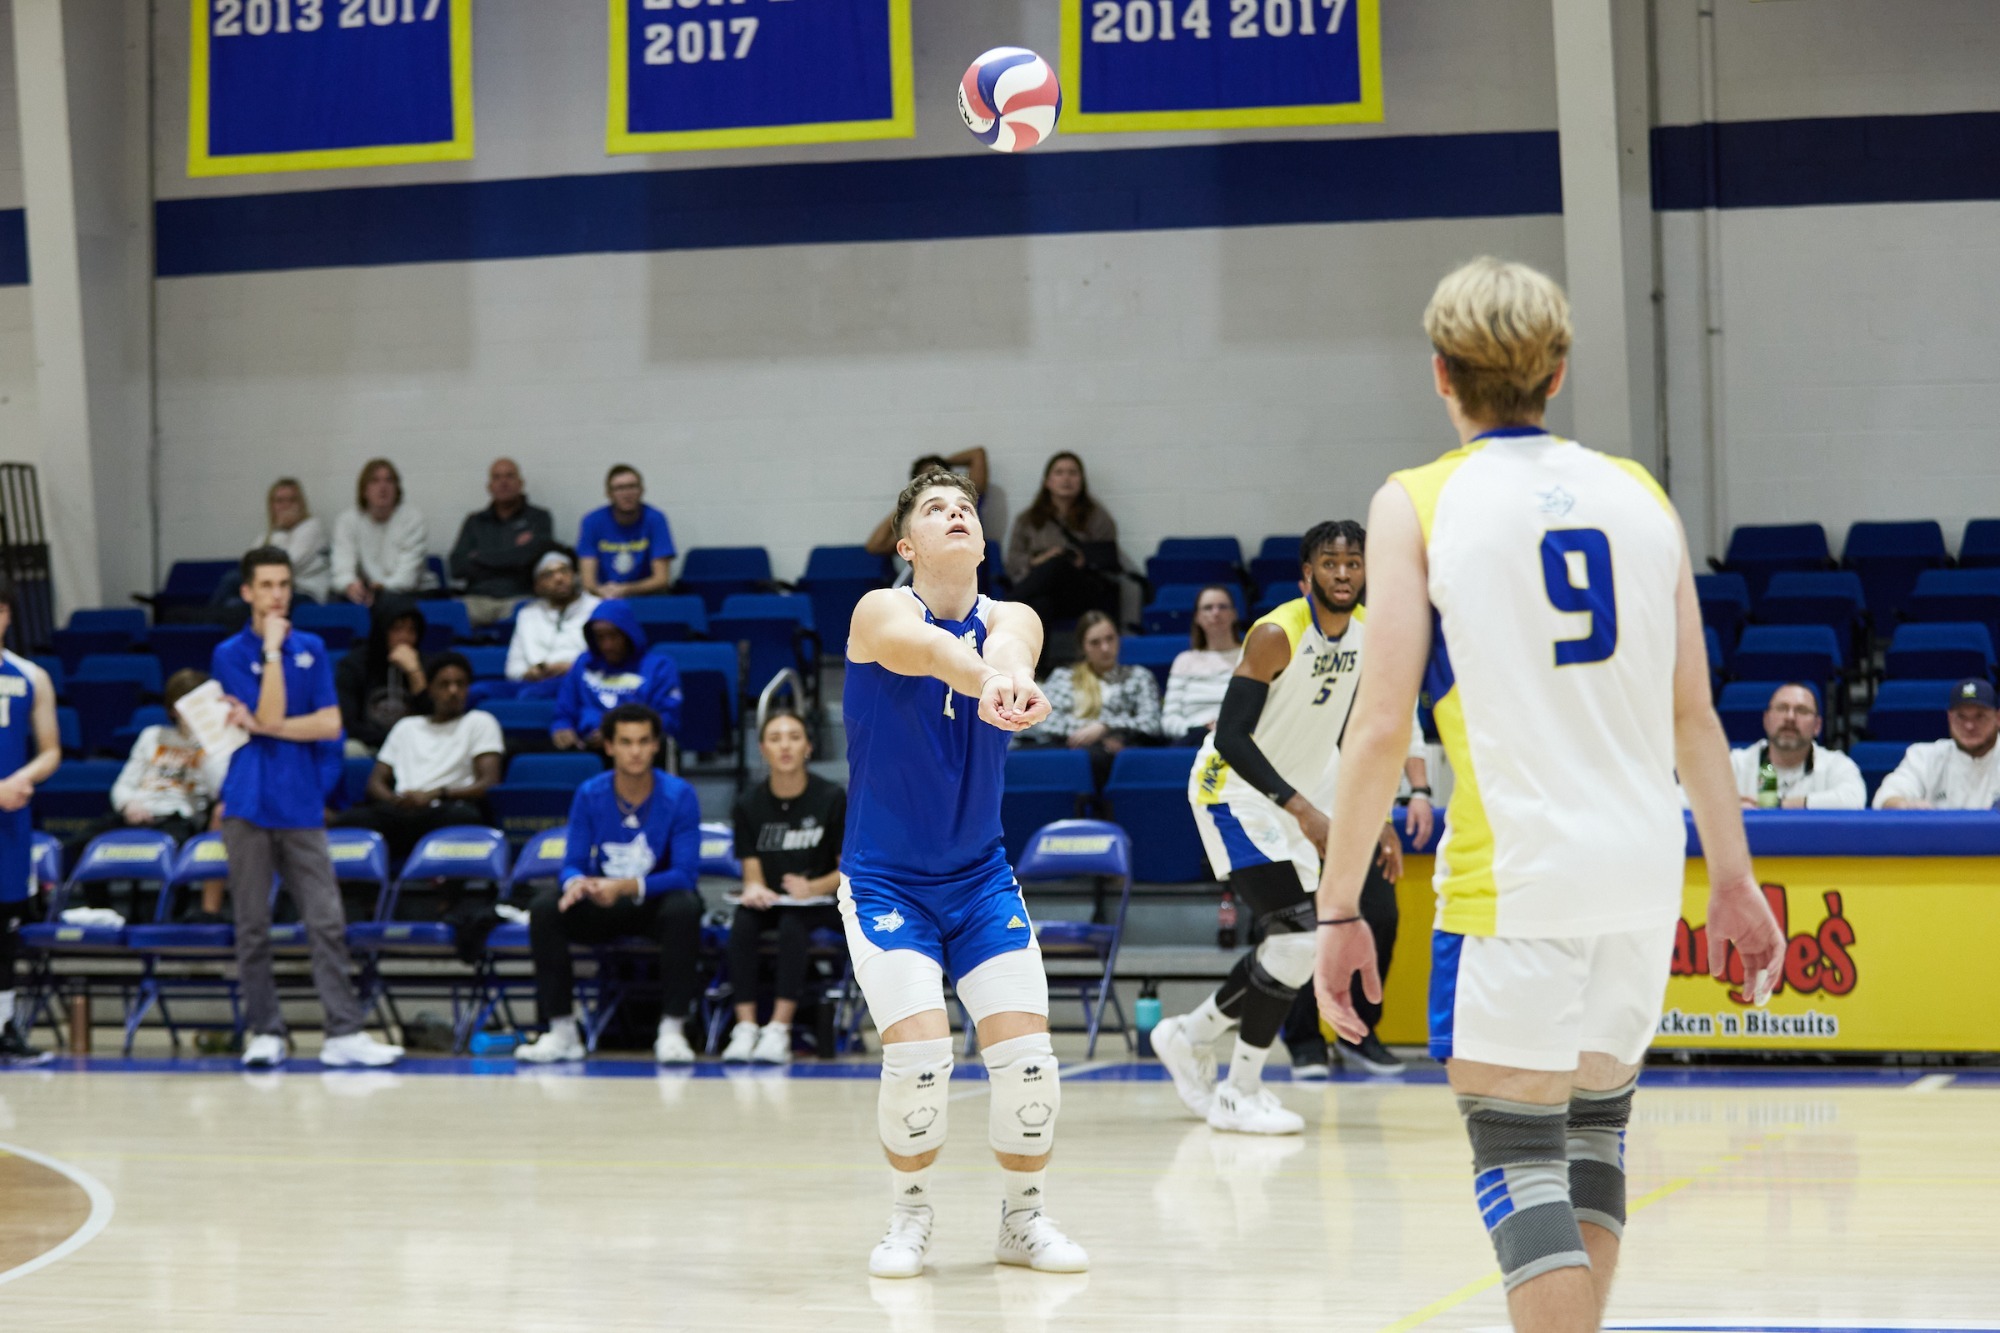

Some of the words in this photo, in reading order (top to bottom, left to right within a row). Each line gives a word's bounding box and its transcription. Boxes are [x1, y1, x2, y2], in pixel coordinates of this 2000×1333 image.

[213, 0, 323, 37] 2013
[1091, 0, 1211, 43] 2014
[1229, 0, 1349, 39] 2017
[644, 17, 760, 65] 2017
[1540, 527, 1618, 668] 9
[1312, 677, 1337, 706] 5
[1655, 1010, 1712, 1033] cken
[1745, 1010, 1837, 1034] Biscuits
